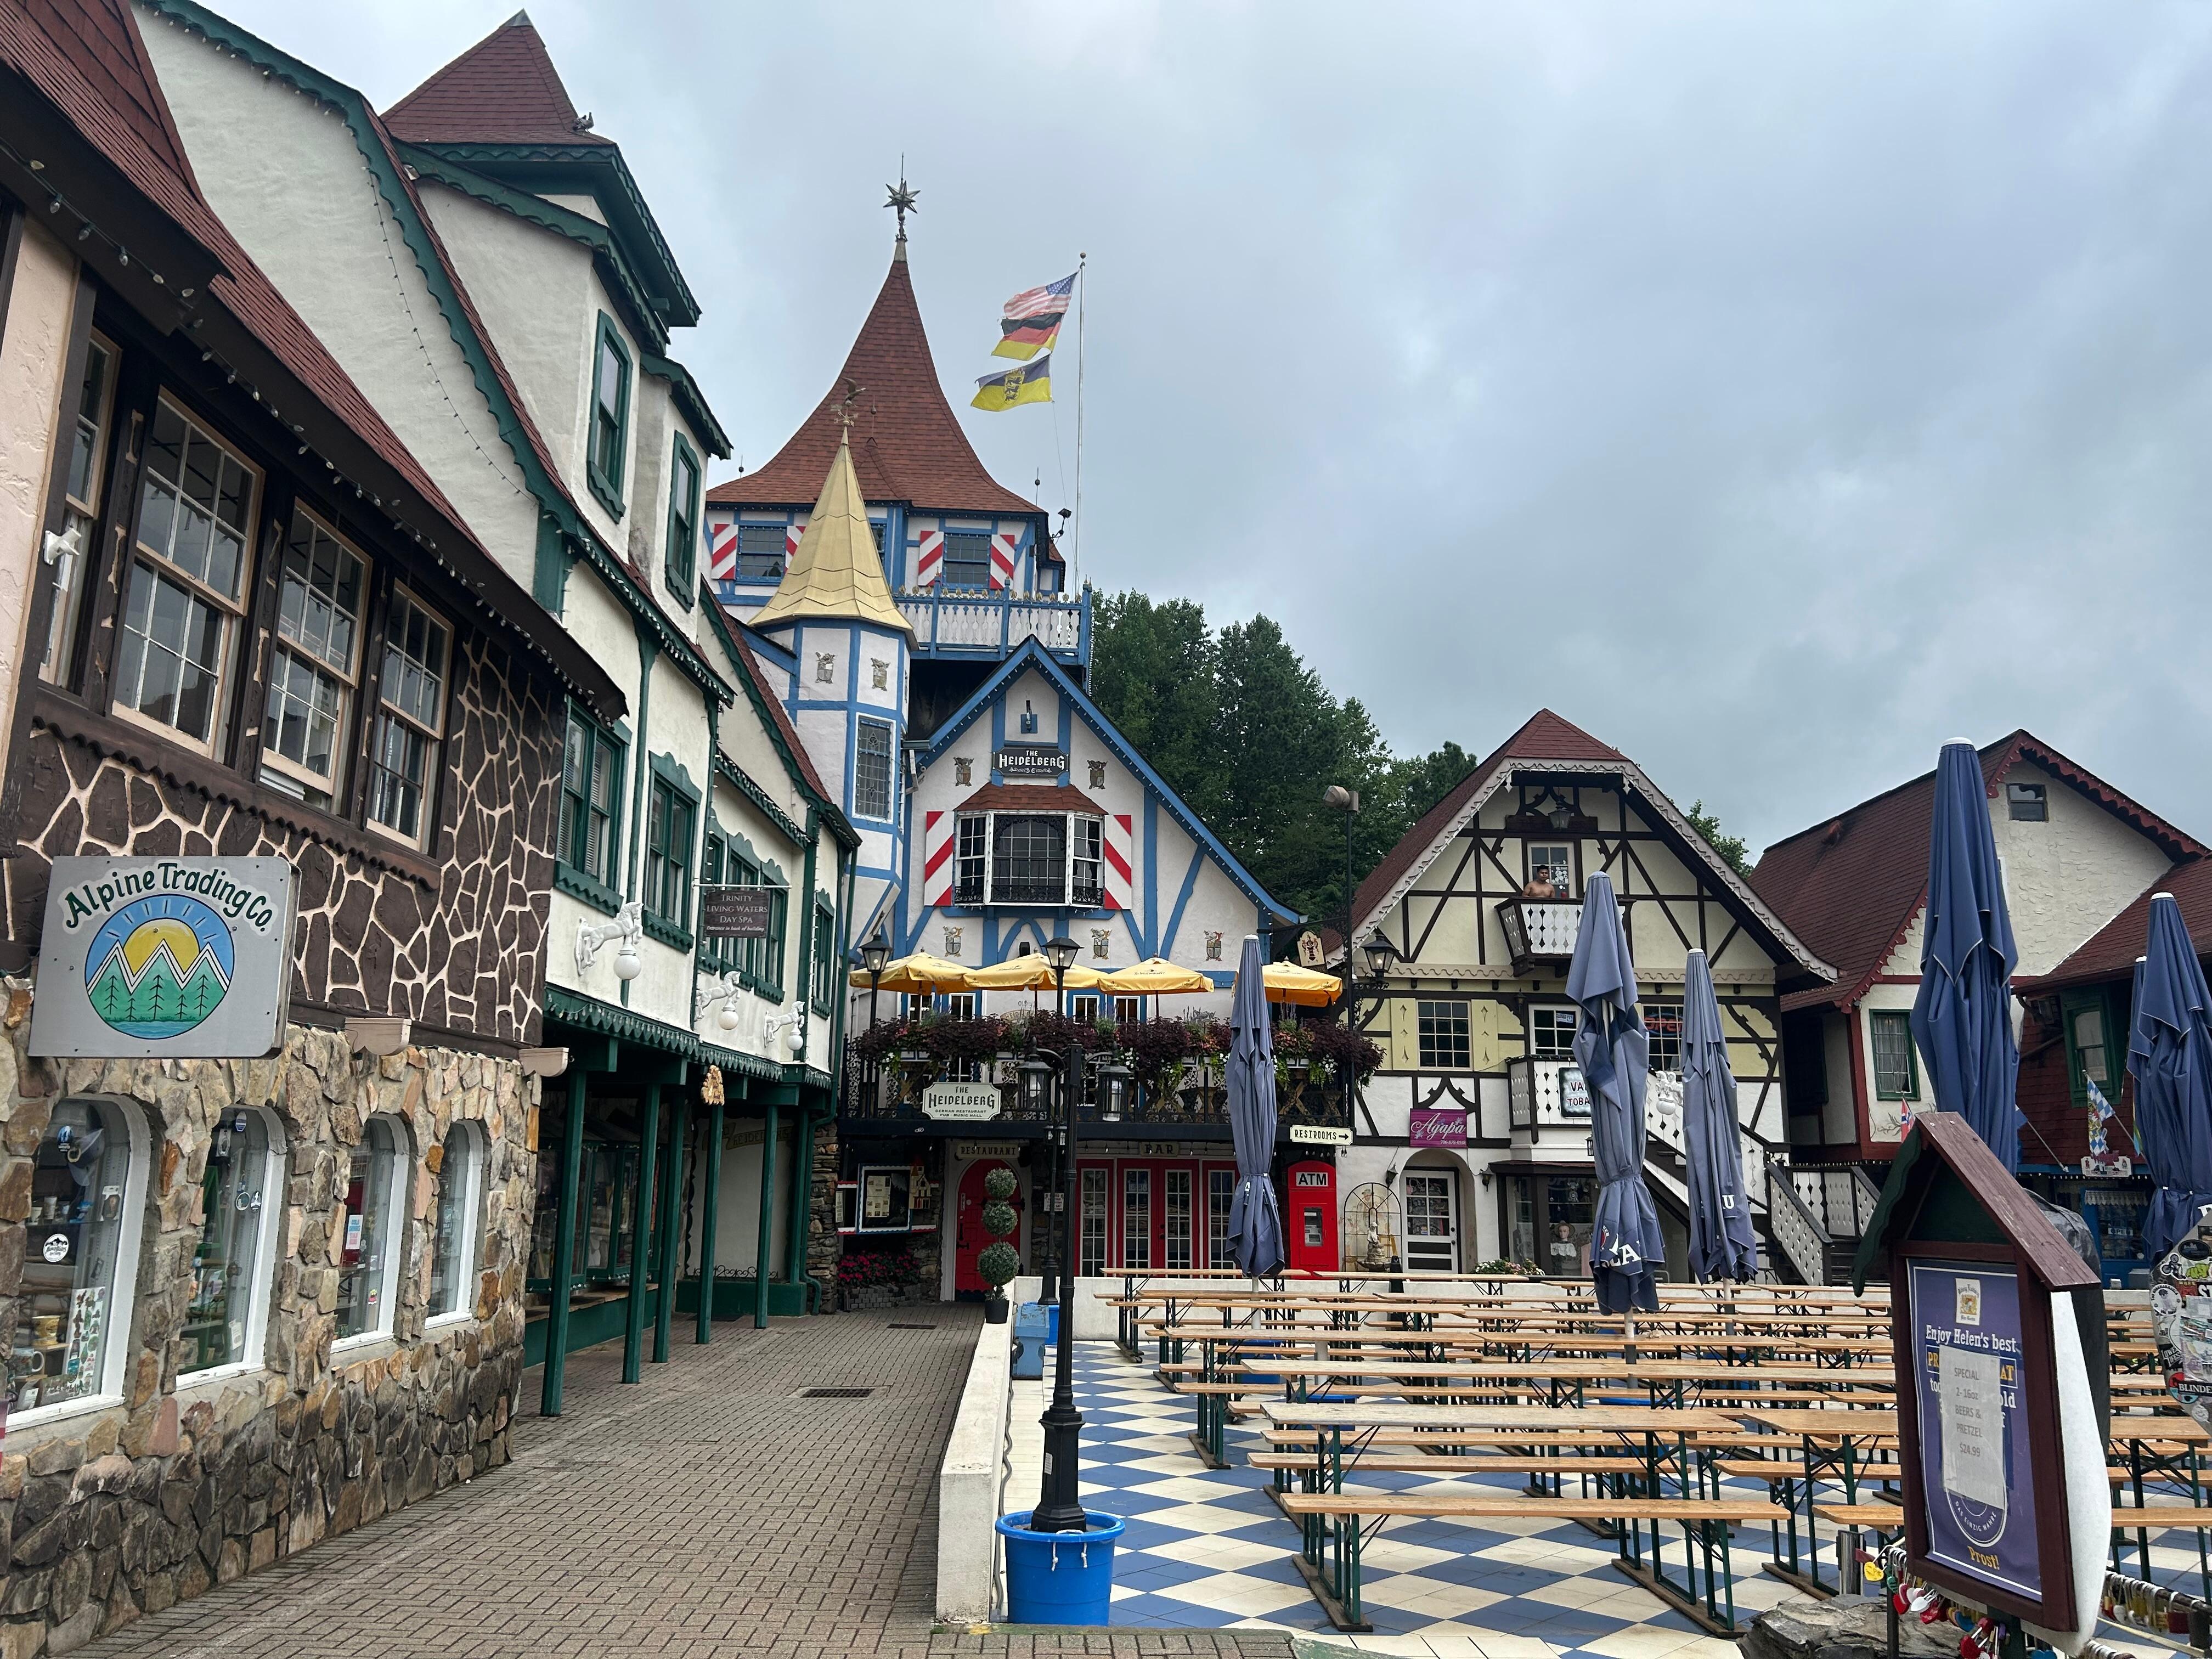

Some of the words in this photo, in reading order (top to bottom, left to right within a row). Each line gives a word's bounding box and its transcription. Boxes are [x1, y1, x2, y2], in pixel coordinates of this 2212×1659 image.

[999, 753, 1065, 770] HEIDELBERG
[65, 870, 156, 928] Alpine
[157, 862, 252, 918] Trading
[245, 895, 273, 932] Co.
[928, 1092, 995, 1110] HEIDELBERG
[1410, 1112, 1466, 1141] Agapa
[1294, 1129, 1338, 1141] RESTROOMS
[961, 1146, 1016, 1155] RESTAURANT
[1144, 1144, 1173, 1154] BAR
[1298, 1173, 1327, 1186] ATM
[1926, 1324, 1951, 1345] Enjoy
[1953, 1328, 1989, 1348] Helen's
[1991, 1334, 2017, 1353] best
[1954, 1367, 1979, 1380] SPECIAL
[1955, 1404, 1974, 1417] BEERS
[1976, 1409, 1982, 1419] &
[1956, 1423, 1983, 1437] PRETZEL
[1959, 1442, 1981, 1457] $24.99
[1955, 1500, 1963, 1516] DAS
[1965, 1516, 1982, 1532] EINZIG
[1983, 1511, 1997, 1531] WAHRE
[1967, 1545, 2000, 1576] Prost!
